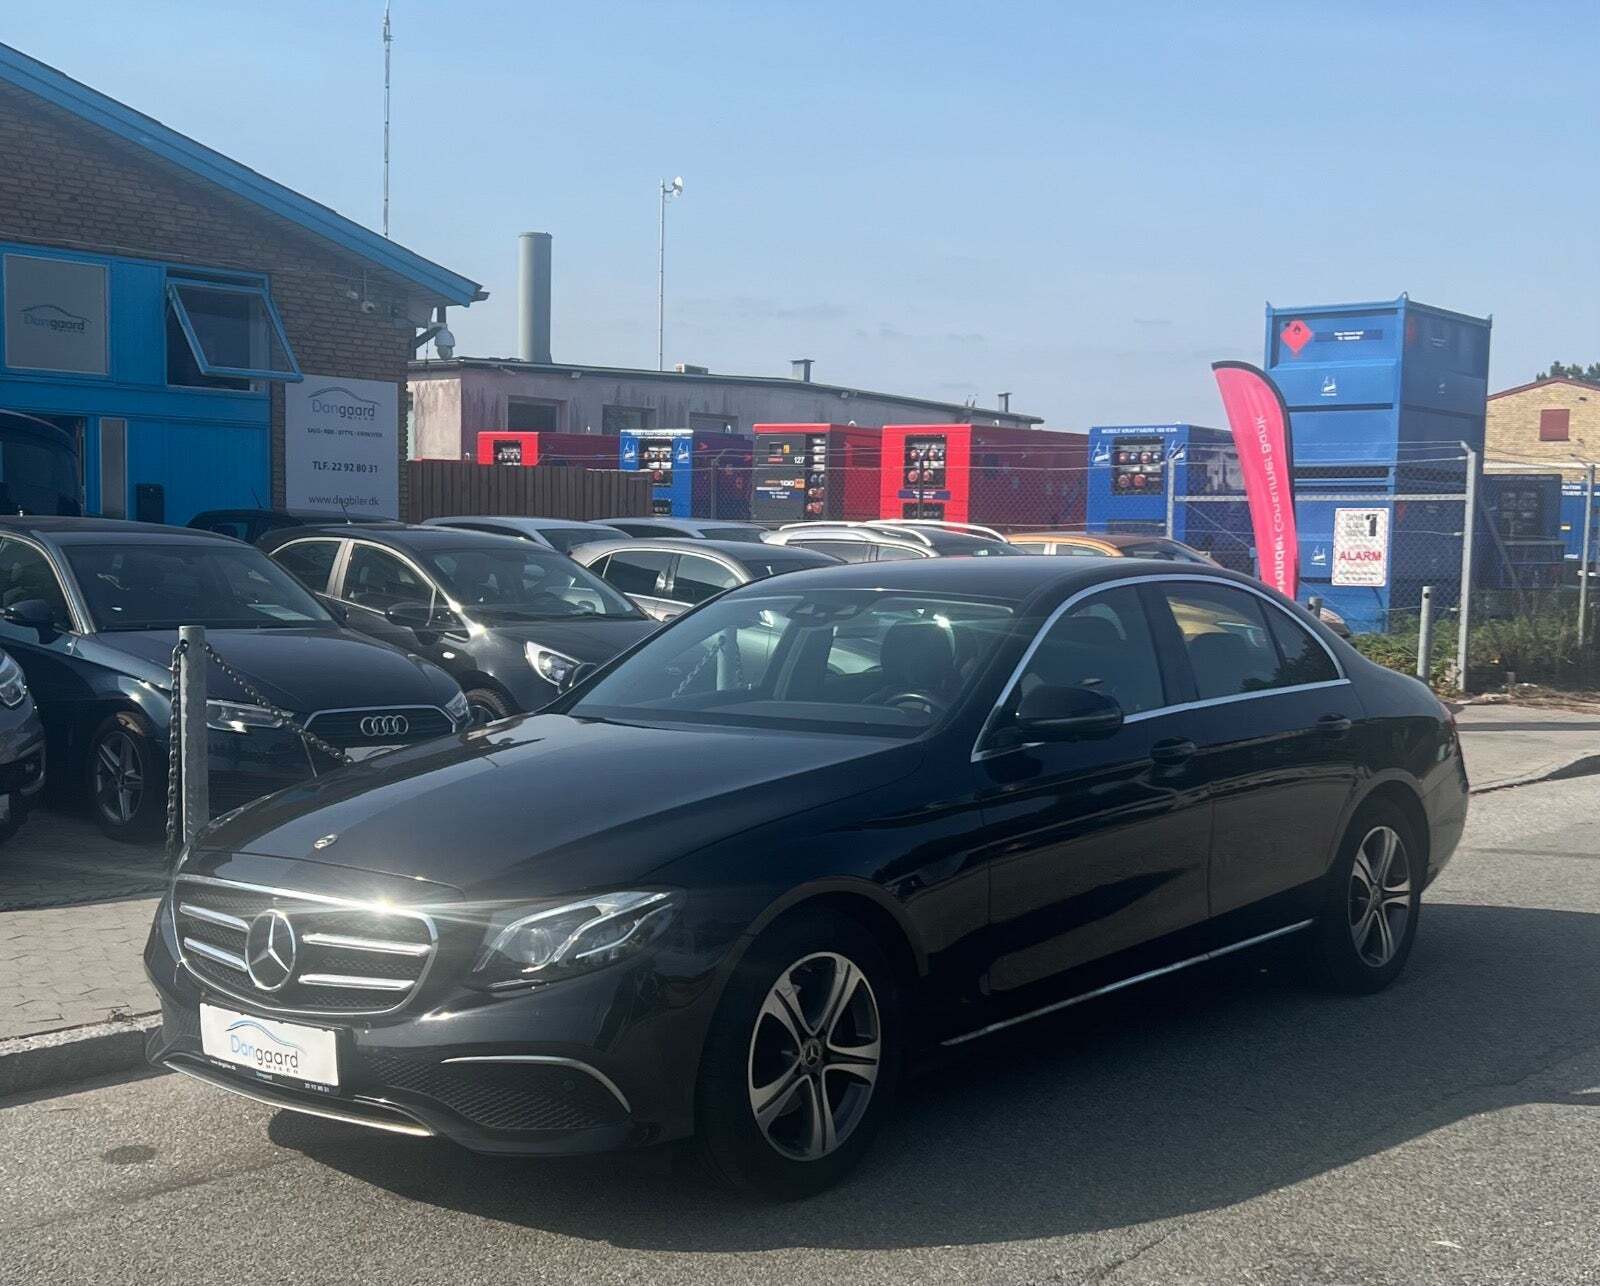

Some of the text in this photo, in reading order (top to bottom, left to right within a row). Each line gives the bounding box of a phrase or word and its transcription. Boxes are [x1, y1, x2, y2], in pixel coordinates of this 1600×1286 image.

[312, 399, 375, 418] Dangaard
[331, 462, 343, 472] 22
[343, 463, 354, 473] 92
[367, 464, 378, 473] 31
[1365, 513, 1378, 537] 1
[1338, 551, 1382, 561] ALARM
[230, 1034, 299, 1068] Dangaard
